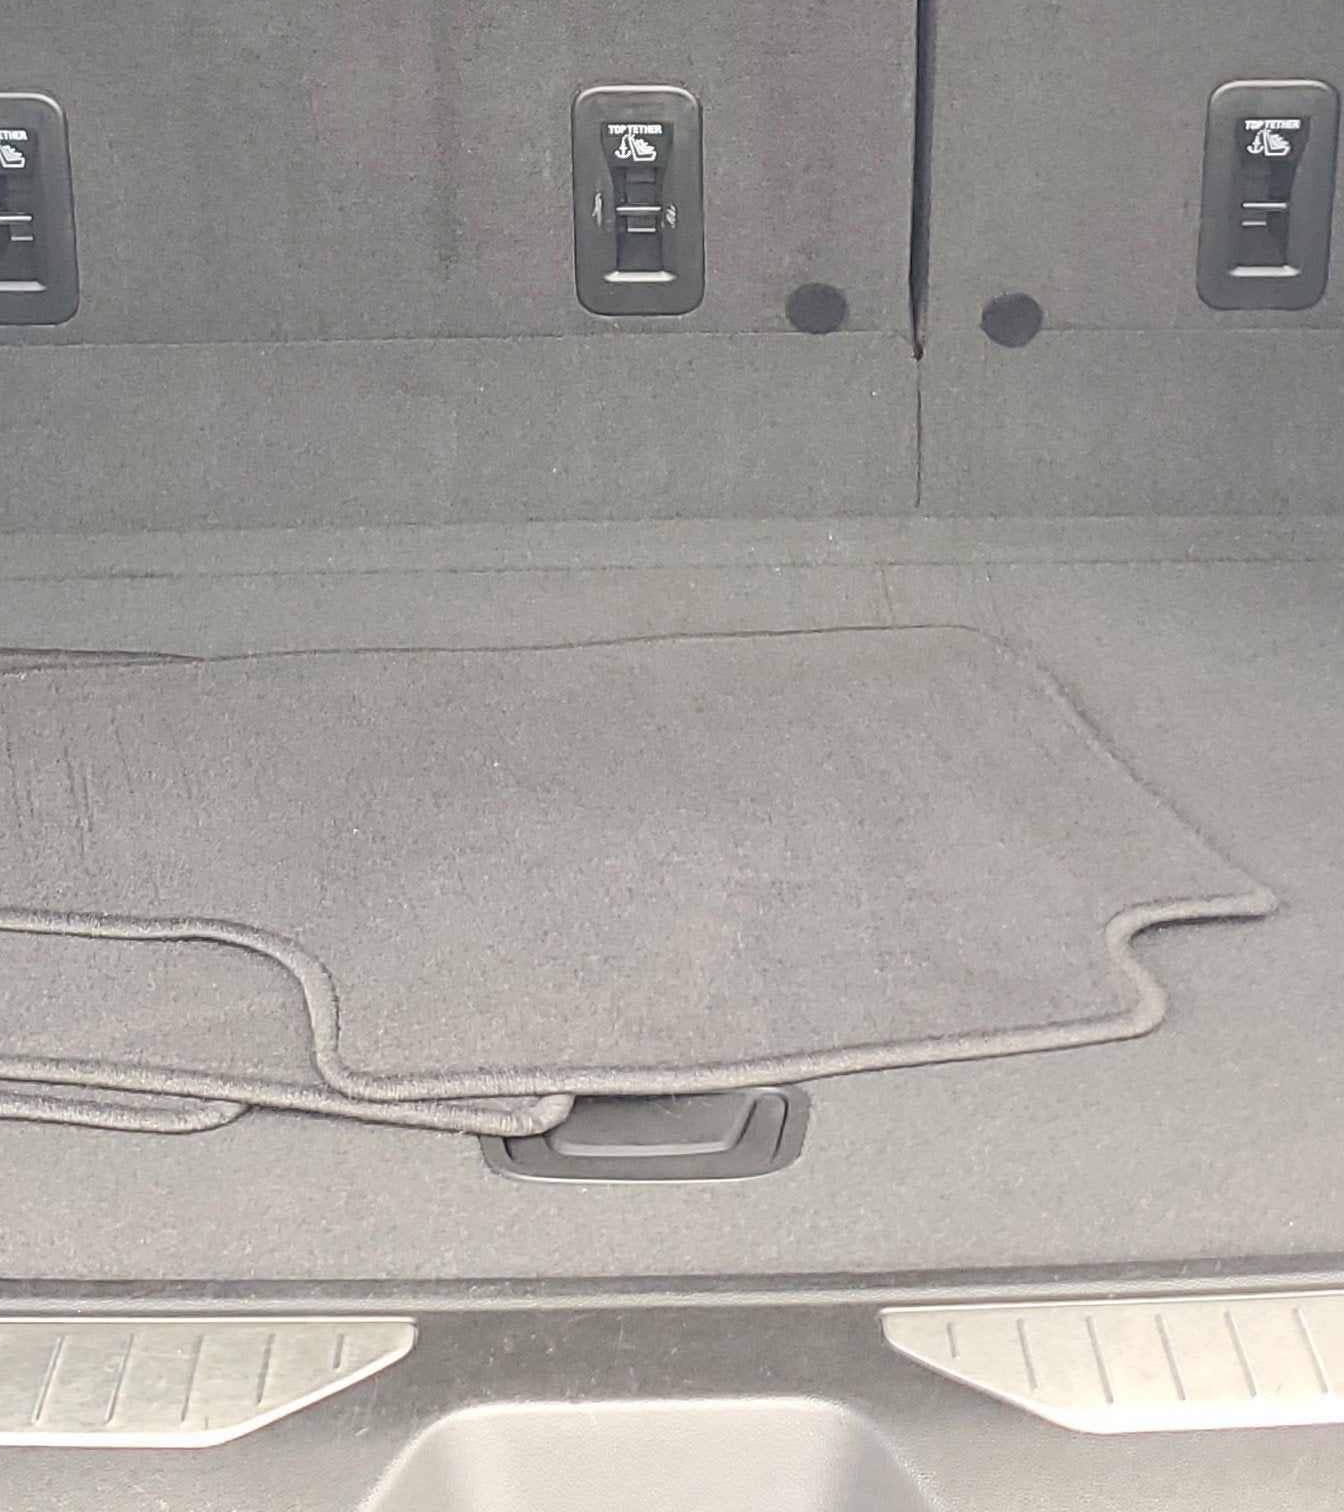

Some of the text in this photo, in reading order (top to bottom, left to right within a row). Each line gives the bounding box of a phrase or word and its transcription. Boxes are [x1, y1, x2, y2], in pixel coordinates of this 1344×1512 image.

[607, 124, 662, 135] TOP TETHER
[1244, 119, 1301, 130] TOP TETHER
